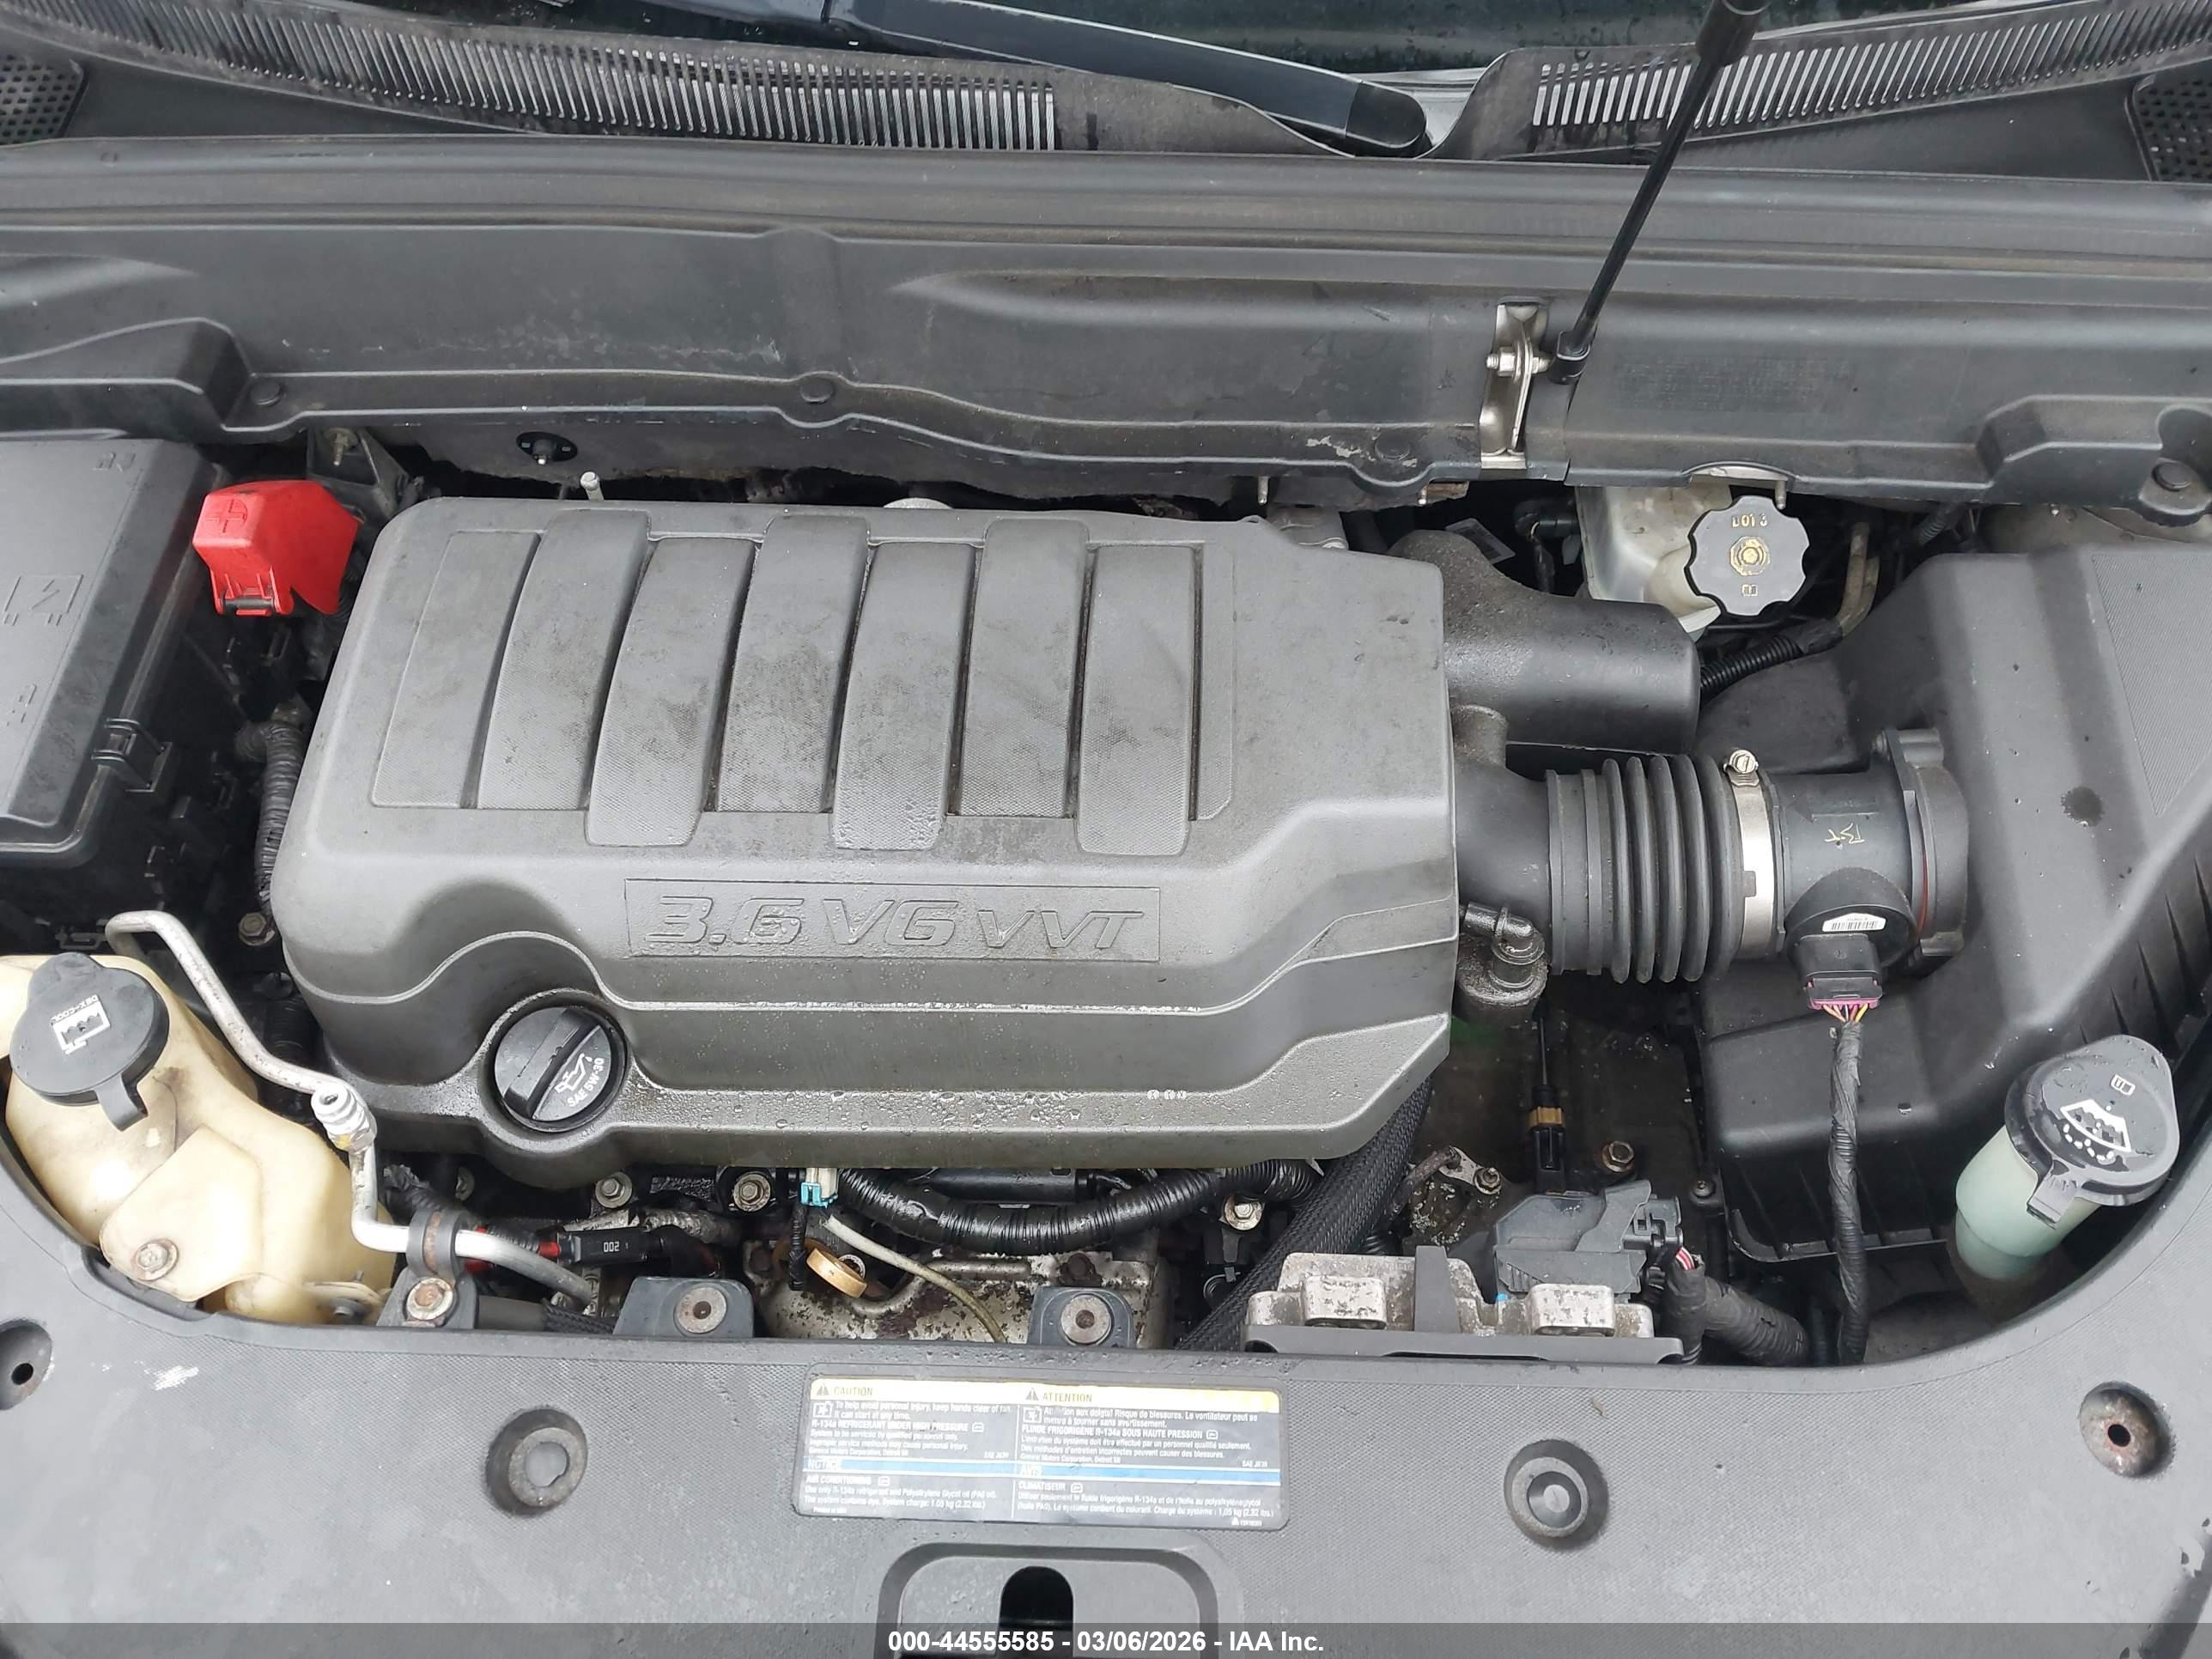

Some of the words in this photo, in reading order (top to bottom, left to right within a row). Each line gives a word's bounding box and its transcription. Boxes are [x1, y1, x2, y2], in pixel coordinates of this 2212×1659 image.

[646, 896, 805, 945] 3.6
[822, 898, 959, 947] V6
[977, 908, 1145, 950] VVT
[567, 1086, 586, 1108] SAE
[586, 1057, 605, 1092] 5W-30
[834, 1386, 872, 1395] CAUTION
[1042, 1391, 1092, 1402] ATTENTION
[1114, 1410, 1137, 1419] Risque
[1167, 1430, 1202, 1438] PRESSION
